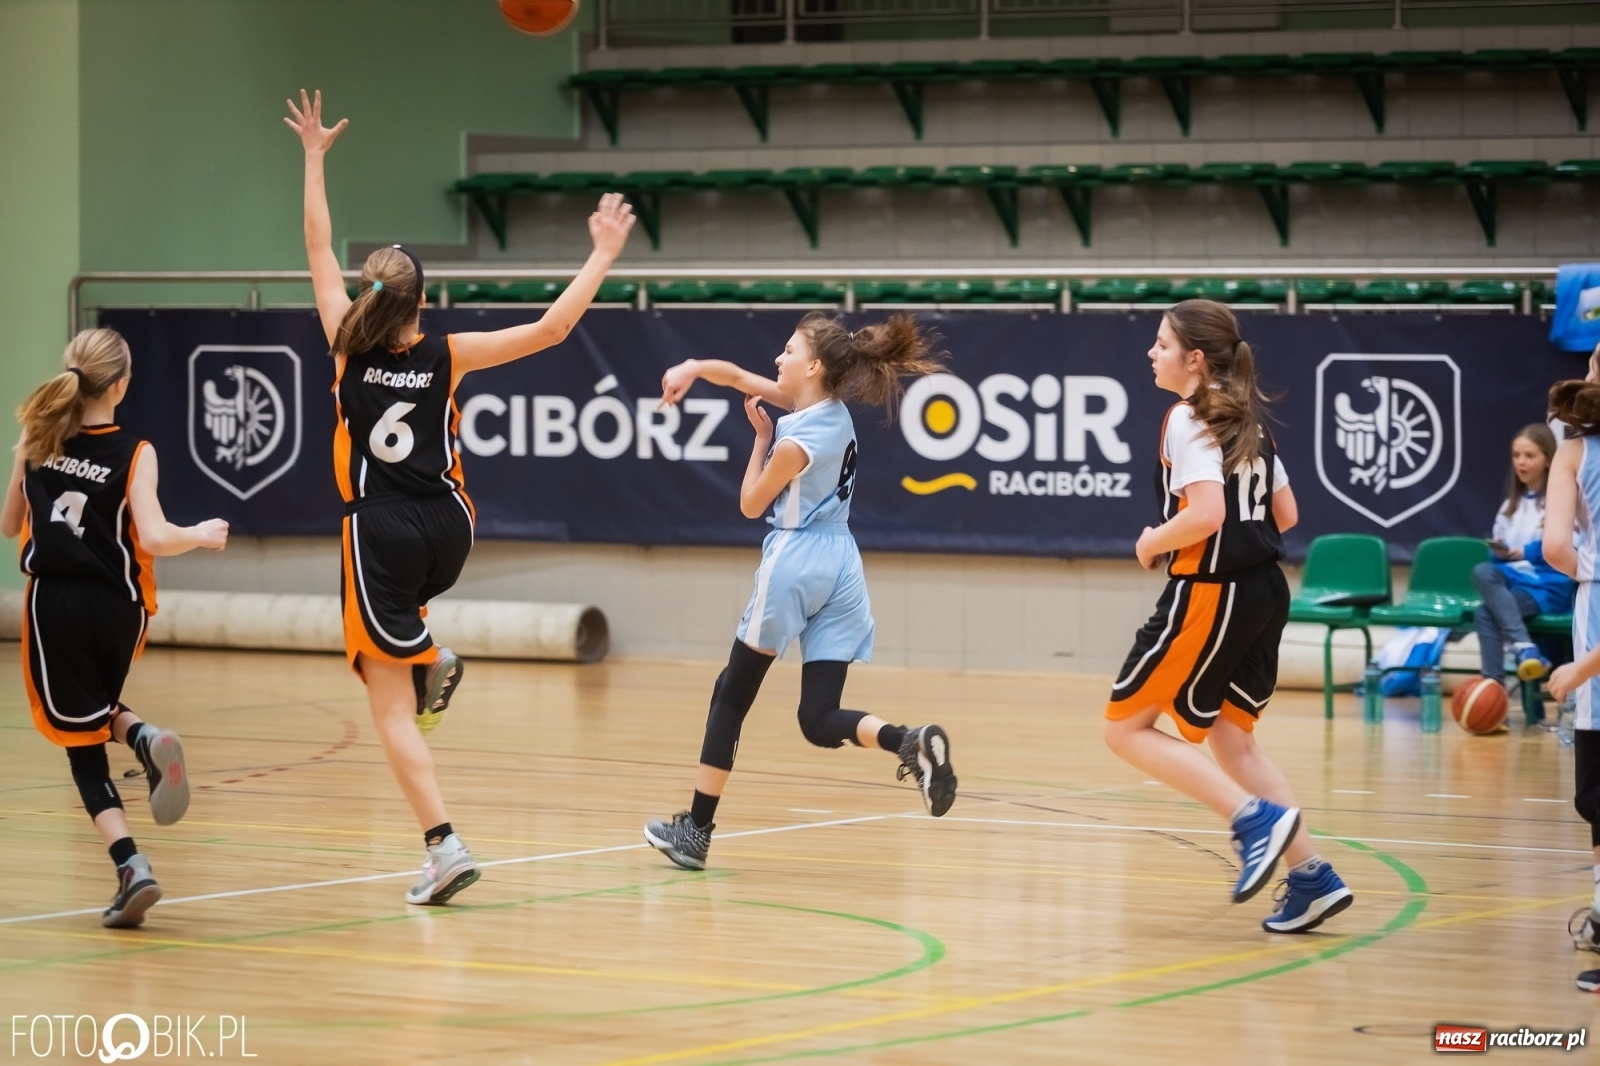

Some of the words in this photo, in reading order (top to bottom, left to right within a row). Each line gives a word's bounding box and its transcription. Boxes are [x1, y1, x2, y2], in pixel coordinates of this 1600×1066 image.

[363, 367, 434, 389] RACIBÓRZ
[368, 401, 417, 464] 6
[454, 373, 730, 461] CIBÓRZ
[43, 453, 112, 484] ACIBÓRZ
[988, 464, 1132, 498] RACIBÓRZ
[1232, 455, 1267, 522] 12
[49, 491, 89, 539] 4
